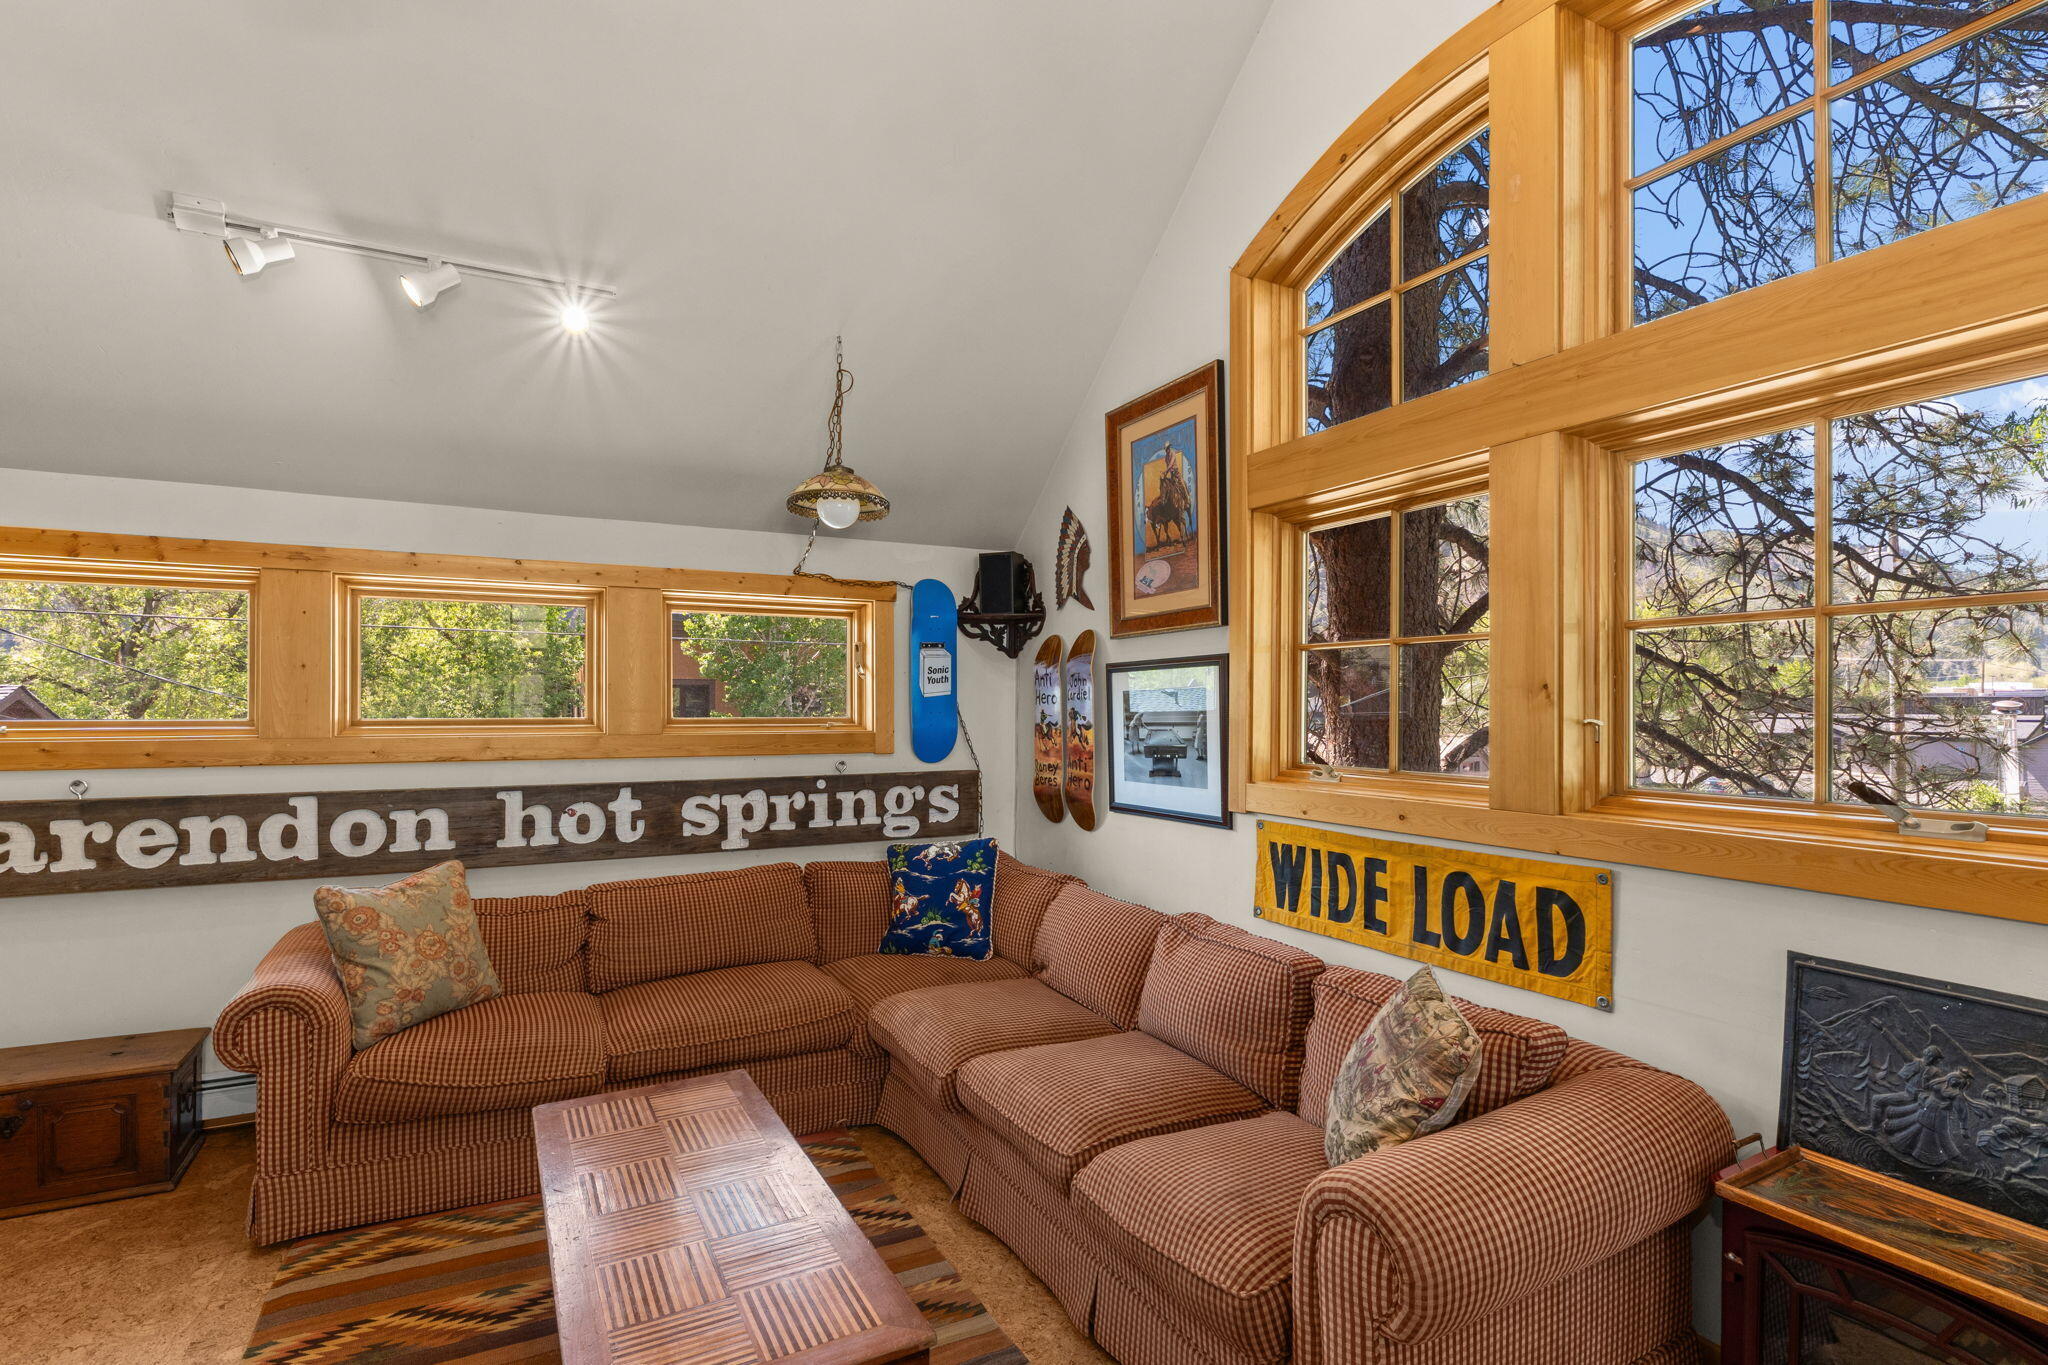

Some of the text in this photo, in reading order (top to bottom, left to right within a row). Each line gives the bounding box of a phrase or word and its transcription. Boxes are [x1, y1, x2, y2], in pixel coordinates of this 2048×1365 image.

[927, 665, 949, 675] Sonic
[1034, 667, 1052, 688] Anti
[927, 675, 949, 685] Youth
[1069, 672, 1088, 688] John
[1035, 689, 1058, 706] Hero
[0, 779, 960, 874] arendon hot springs
[1268, 841, 1586, 978] WIDE LOAD
